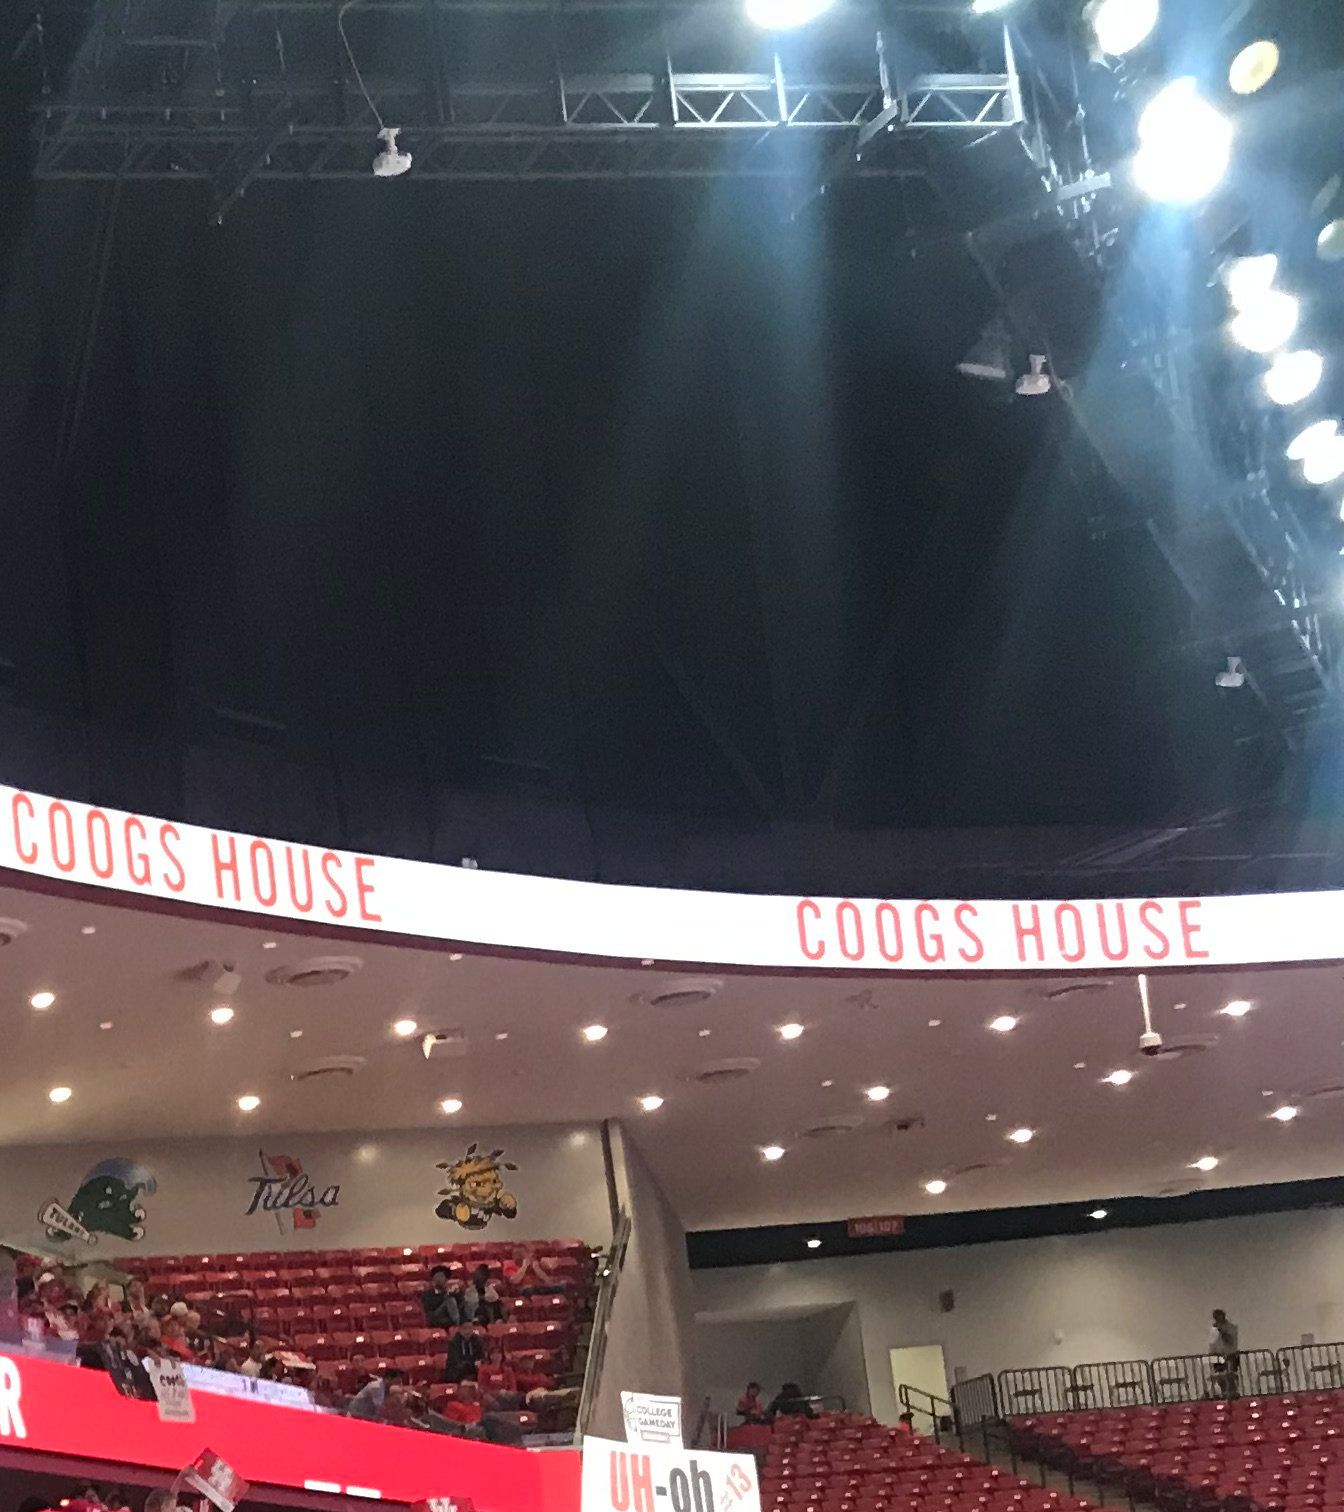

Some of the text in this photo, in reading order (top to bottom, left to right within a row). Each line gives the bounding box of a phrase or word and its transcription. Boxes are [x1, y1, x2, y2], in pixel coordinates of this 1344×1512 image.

[11, 791, 383, 923] COOGS HOUSE
[795, 897, 1211, 963] COOGS HOUSE
[245, 1173, 341, 1216] Tulsa
[635, 1404, 673, 1418] COLLEGE
[637, 1416, 676, 1430] GAMEDAY
